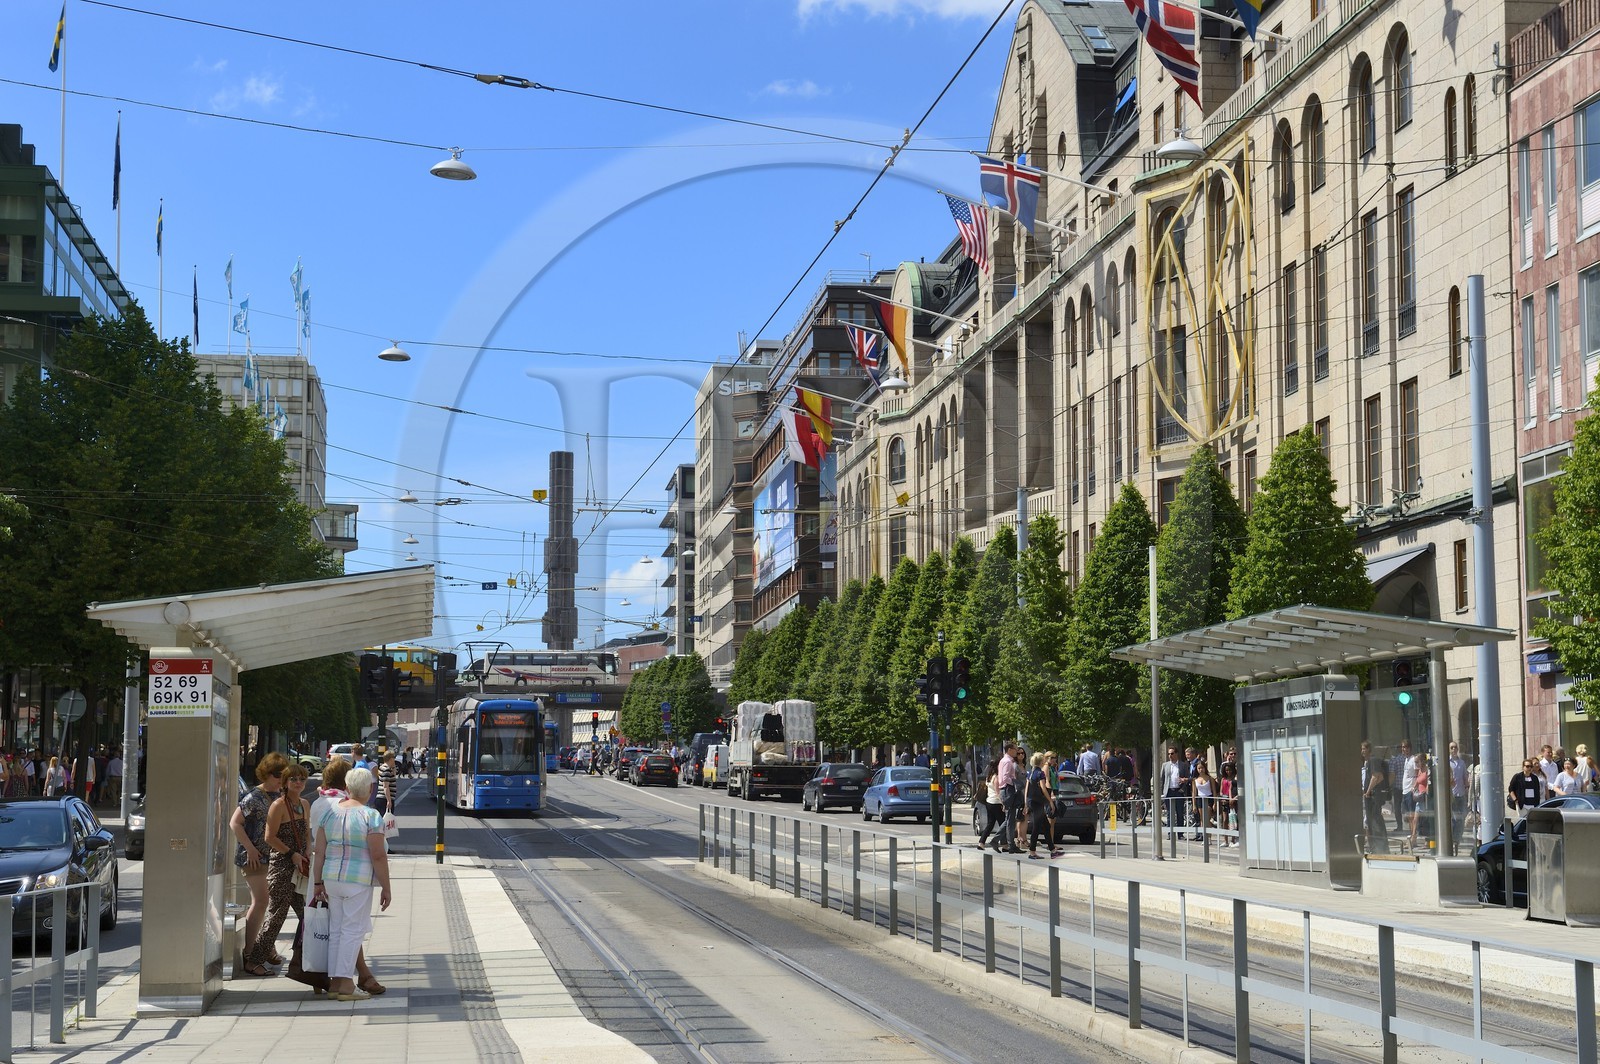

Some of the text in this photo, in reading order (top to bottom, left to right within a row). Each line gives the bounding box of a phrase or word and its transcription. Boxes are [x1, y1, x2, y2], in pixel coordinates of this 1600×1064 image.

[154, 676, 197, 688] 52 69
[154, 690, 207, 703] 69K 91
[1329, 691, 1334, 699] 7
